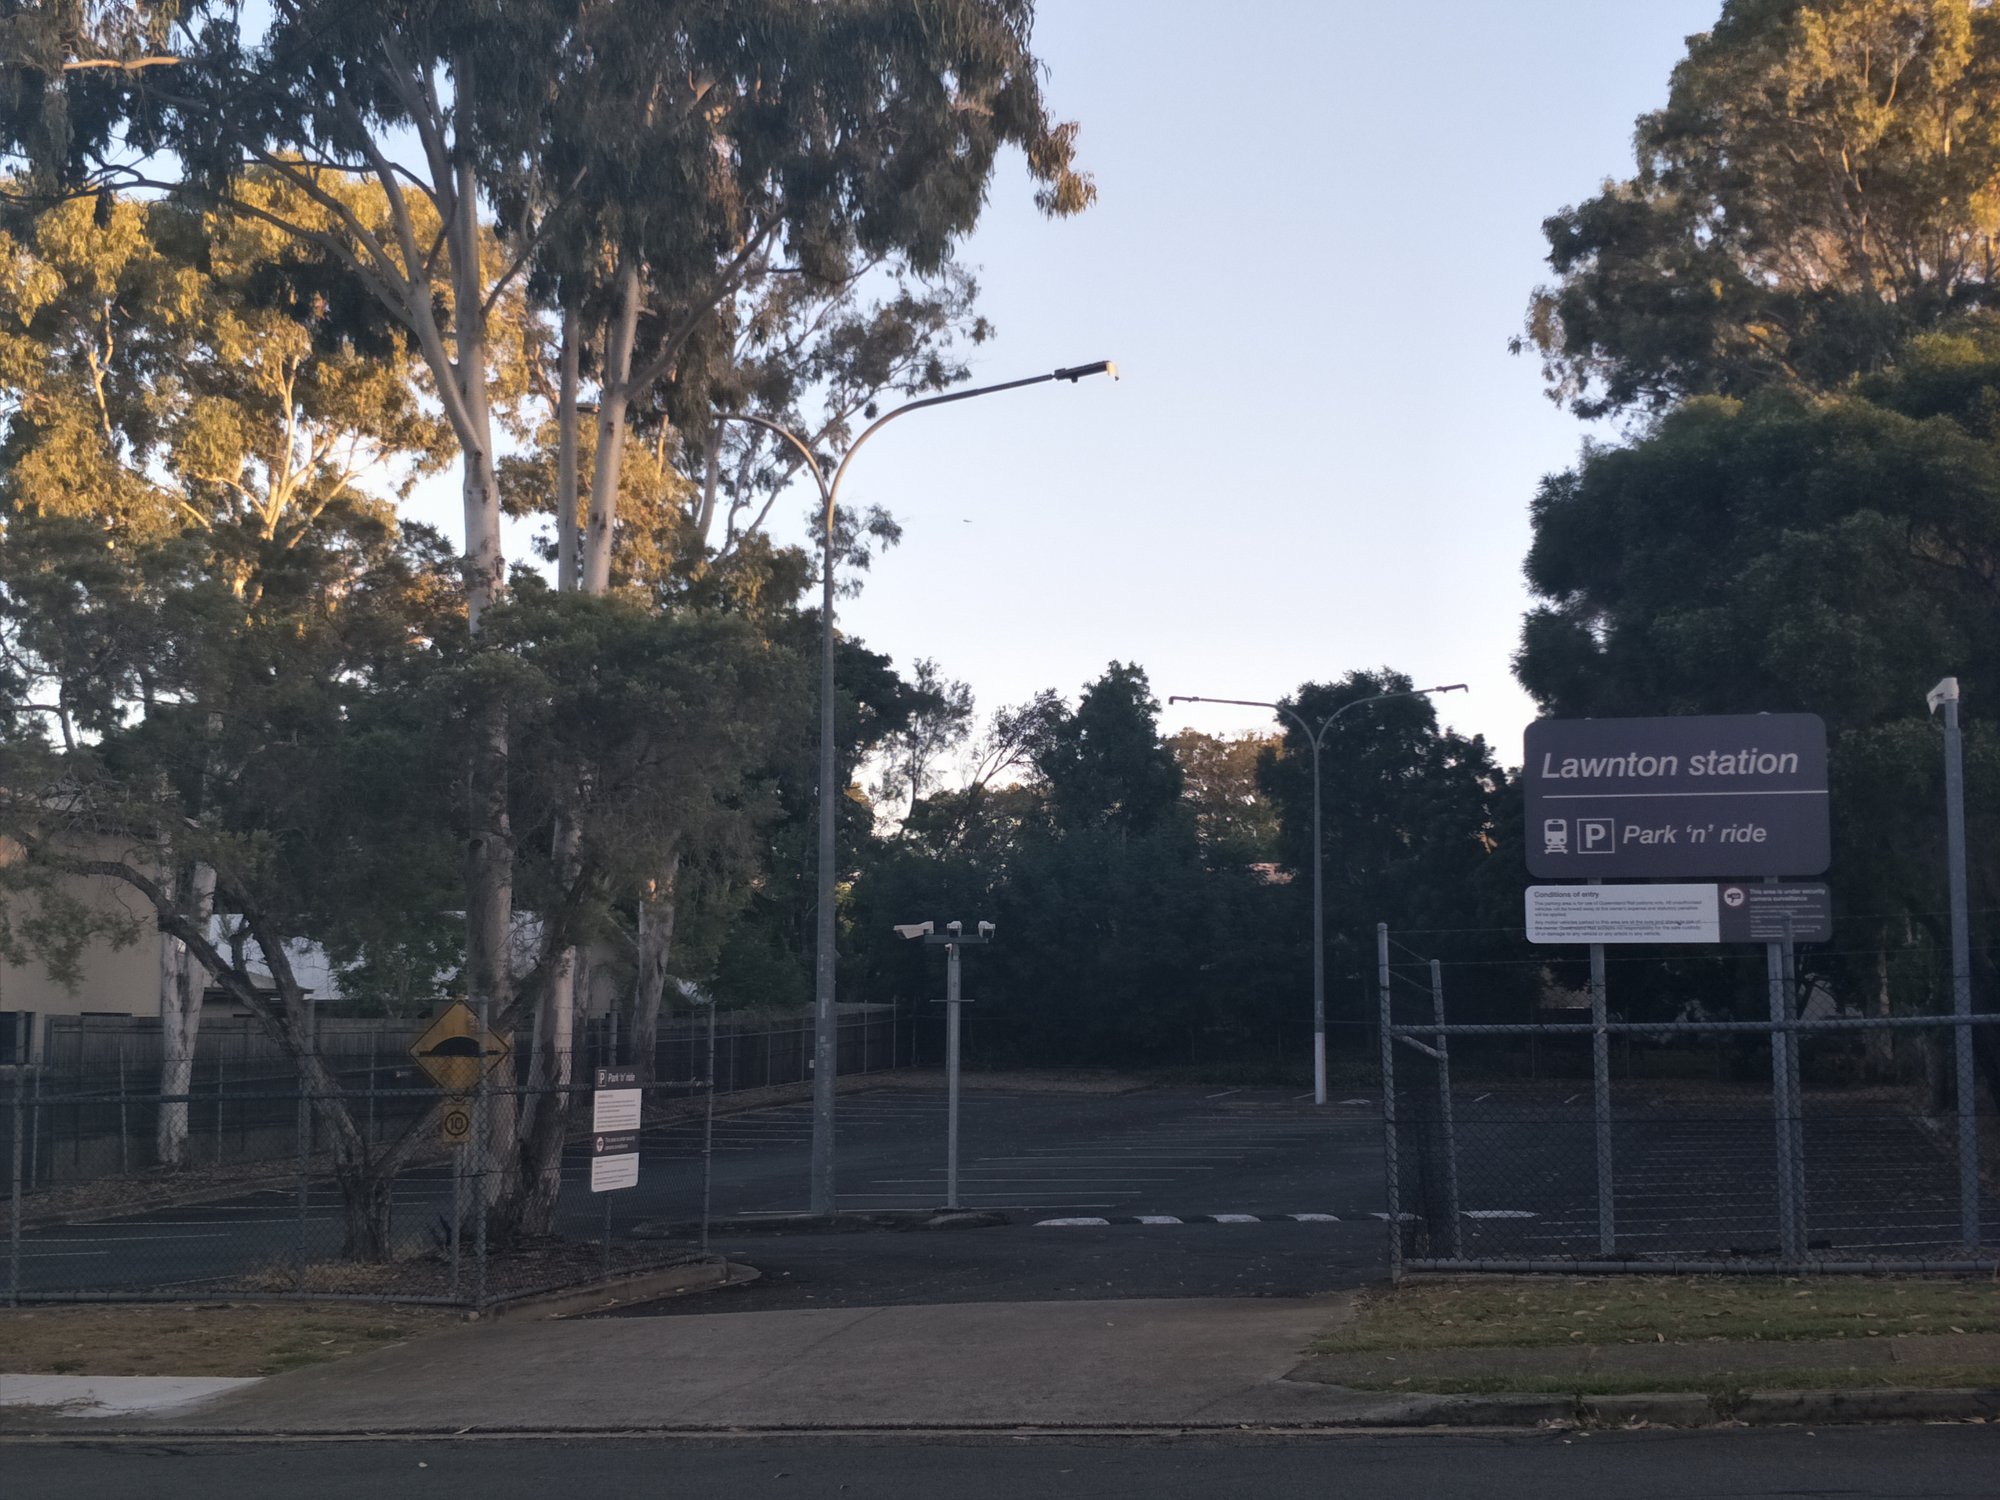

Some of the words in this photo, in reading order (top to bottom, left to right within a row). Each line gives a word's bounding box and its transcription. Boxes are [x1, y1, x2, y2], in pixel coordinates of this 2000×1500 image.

[1542, 752, 1678, 779] Lawnton
[1688, 748, 1798, 776] station
[1585, 823, 1606, 849] P
[1623, 825, 1677, 844] Park
[1720, 823, 1767, 842] ride
[1581, 891, 1599, 899] entry
[600, 1072, 605, 1084] P
[608, 1072, 619, 1083] Park
[450, 1117, 463, 1130] 10
